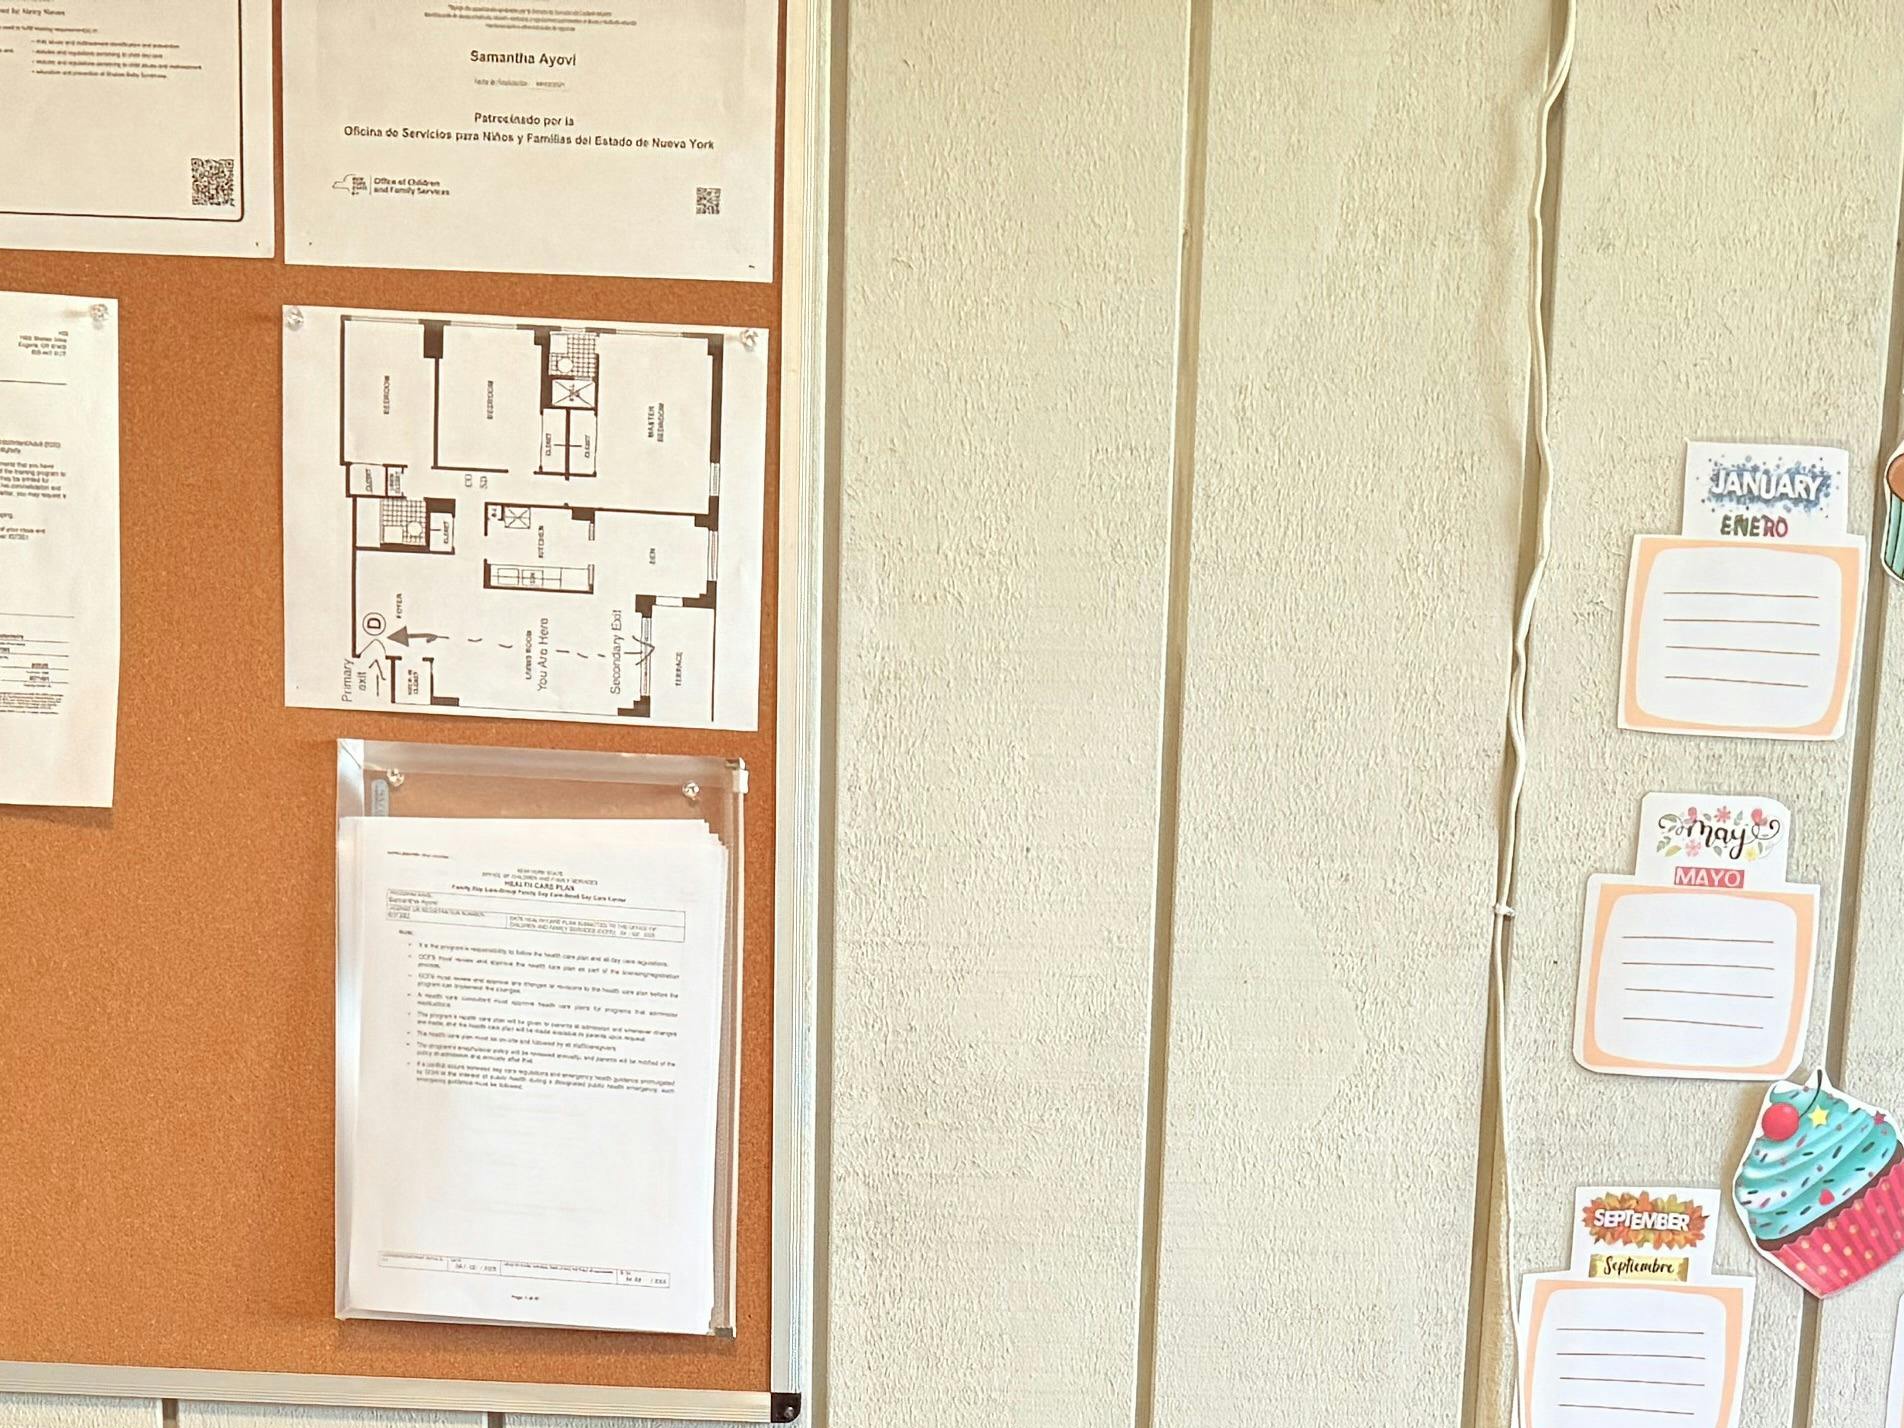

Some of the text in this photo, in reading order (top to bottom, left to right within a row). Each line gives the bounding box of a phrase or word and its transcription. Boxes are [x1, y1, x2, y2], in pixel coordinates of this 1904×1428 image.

[469, 49, 577, 69] Samantha Ayovi
[473, 112, 575, 129] Patrocinado por la
[343, 125, 715, 151] Oficina de Servicios para Niños y Familias del Estado de Nueva York
[383, 375, 391, 415] BEDROOM
[486, 379, 495, 420] BEDROOM
[647, 405, 655, 438] MASTER
[1711, 468, 1823, 503] JANUARY
[1719, 512, 1789, 539] ENERO
[537, 617, 549, 692] You Are Here
[610, 609, 625, 695] Secondary Exit
[341, 658, 355, 703] Primary
[356, 671, 367, 691] exit
[1675, 867, 1744, 887] MAYO
[1592, 1207, 1692, 1233] SEPTEMBER
[1602, 1255, 1676, 1277] Septiembre
